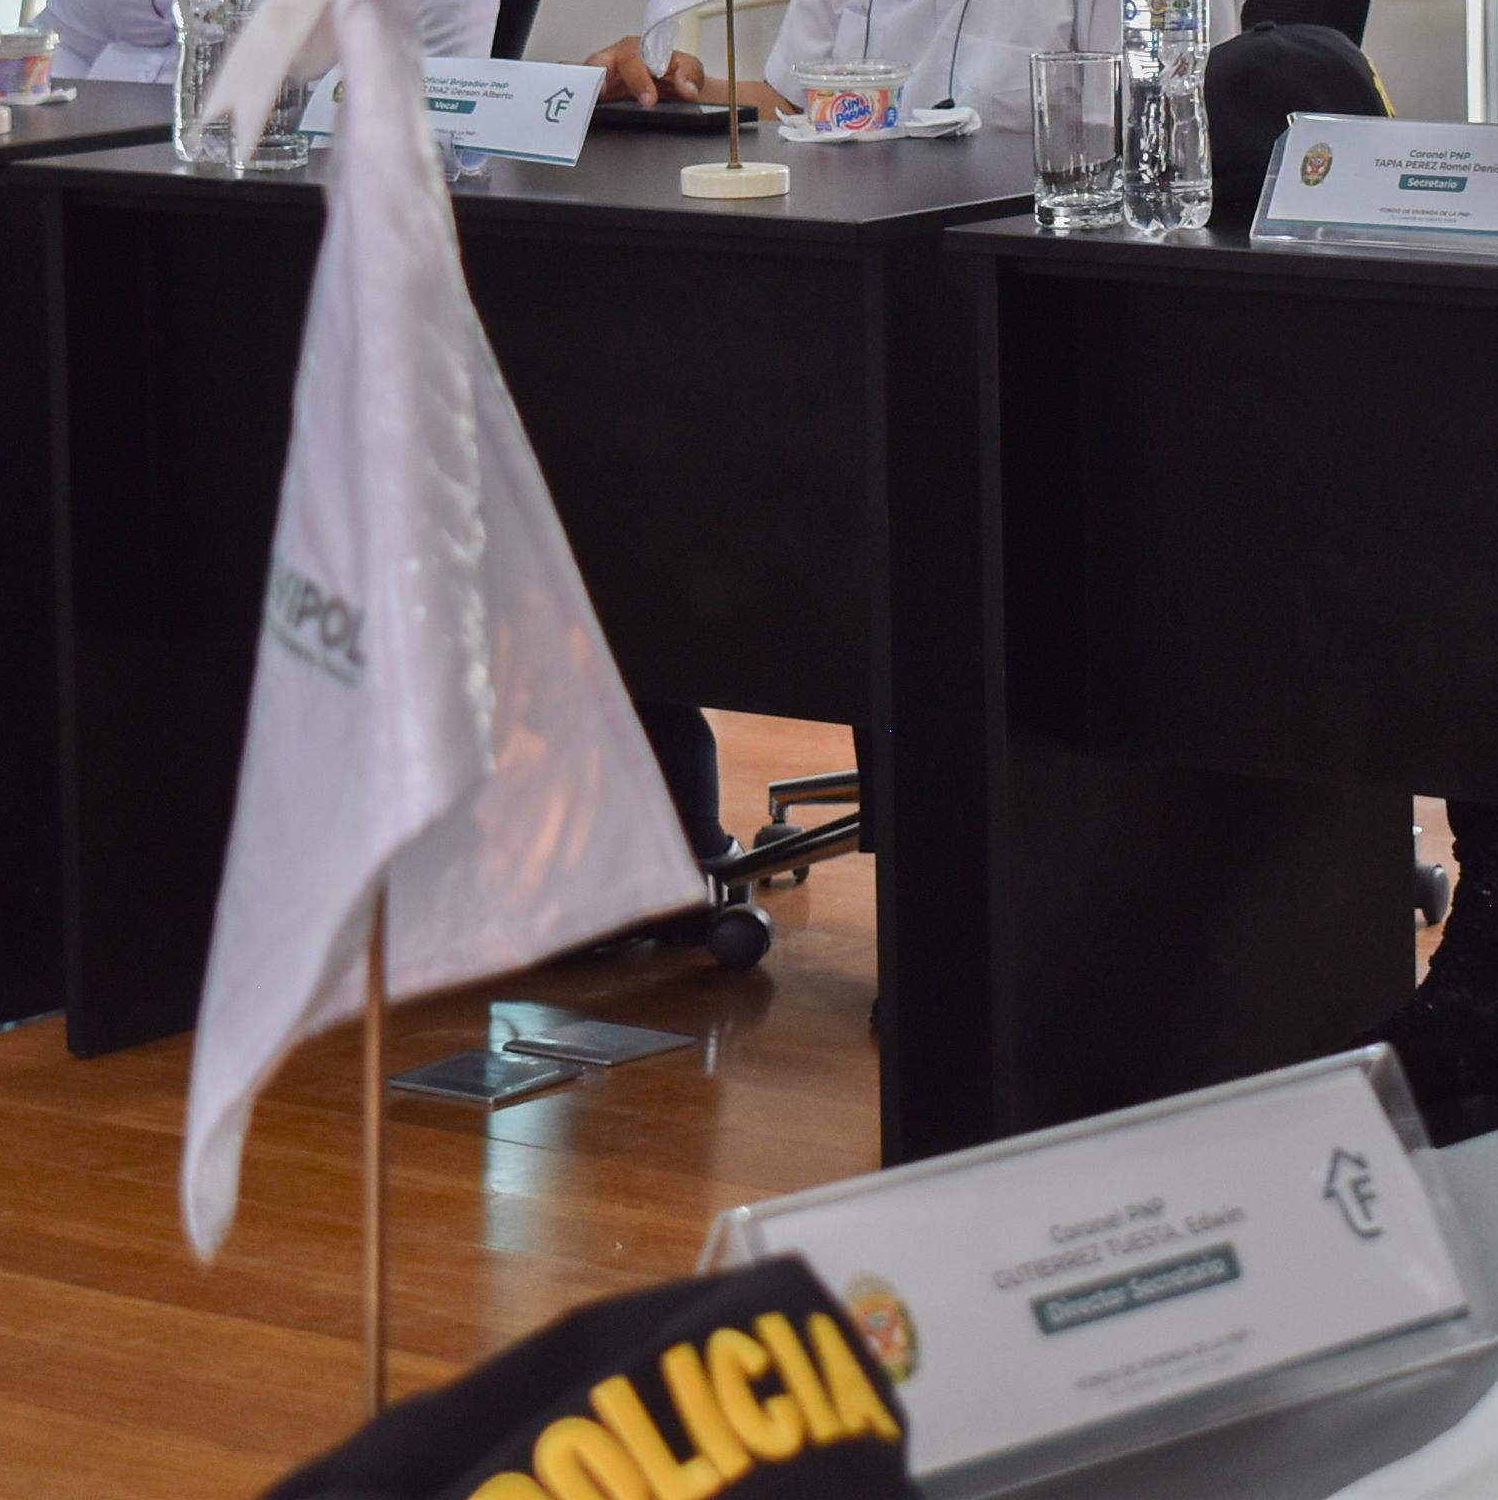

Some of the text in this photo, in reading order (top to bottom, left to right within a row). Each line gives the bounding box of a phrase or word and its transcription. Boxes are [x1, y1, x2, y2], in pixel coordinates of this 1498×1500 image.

[450, 77, 489, 89] Brigadier
[490, 81, 510, 89] PNP
[428, 85, 450, 95] DIAZ
[451, 88, 481, 97] Gerson
[483, 90, 514, 99] Alberto
[434, 101, 460, 111] Vocal
[842, 97, 860, 114] SIN
[836, 104, 871, 128] PARAR
[1409, 149, 1471, 160] Coronel PNP
[1374, 158, 1402, 169] TAPIA
[1405, 160, 1438, 171] PEREZ
[1439, 161, 1472, 172] Romel
[1407, 177, 1458, 189] Secretario
[1049, 1197, 1167, 1245] Coronel PNP
[992, 1243, 1105, 1290] GUTIERREZ
[466, 1311, 901, 1500] OLICIA
